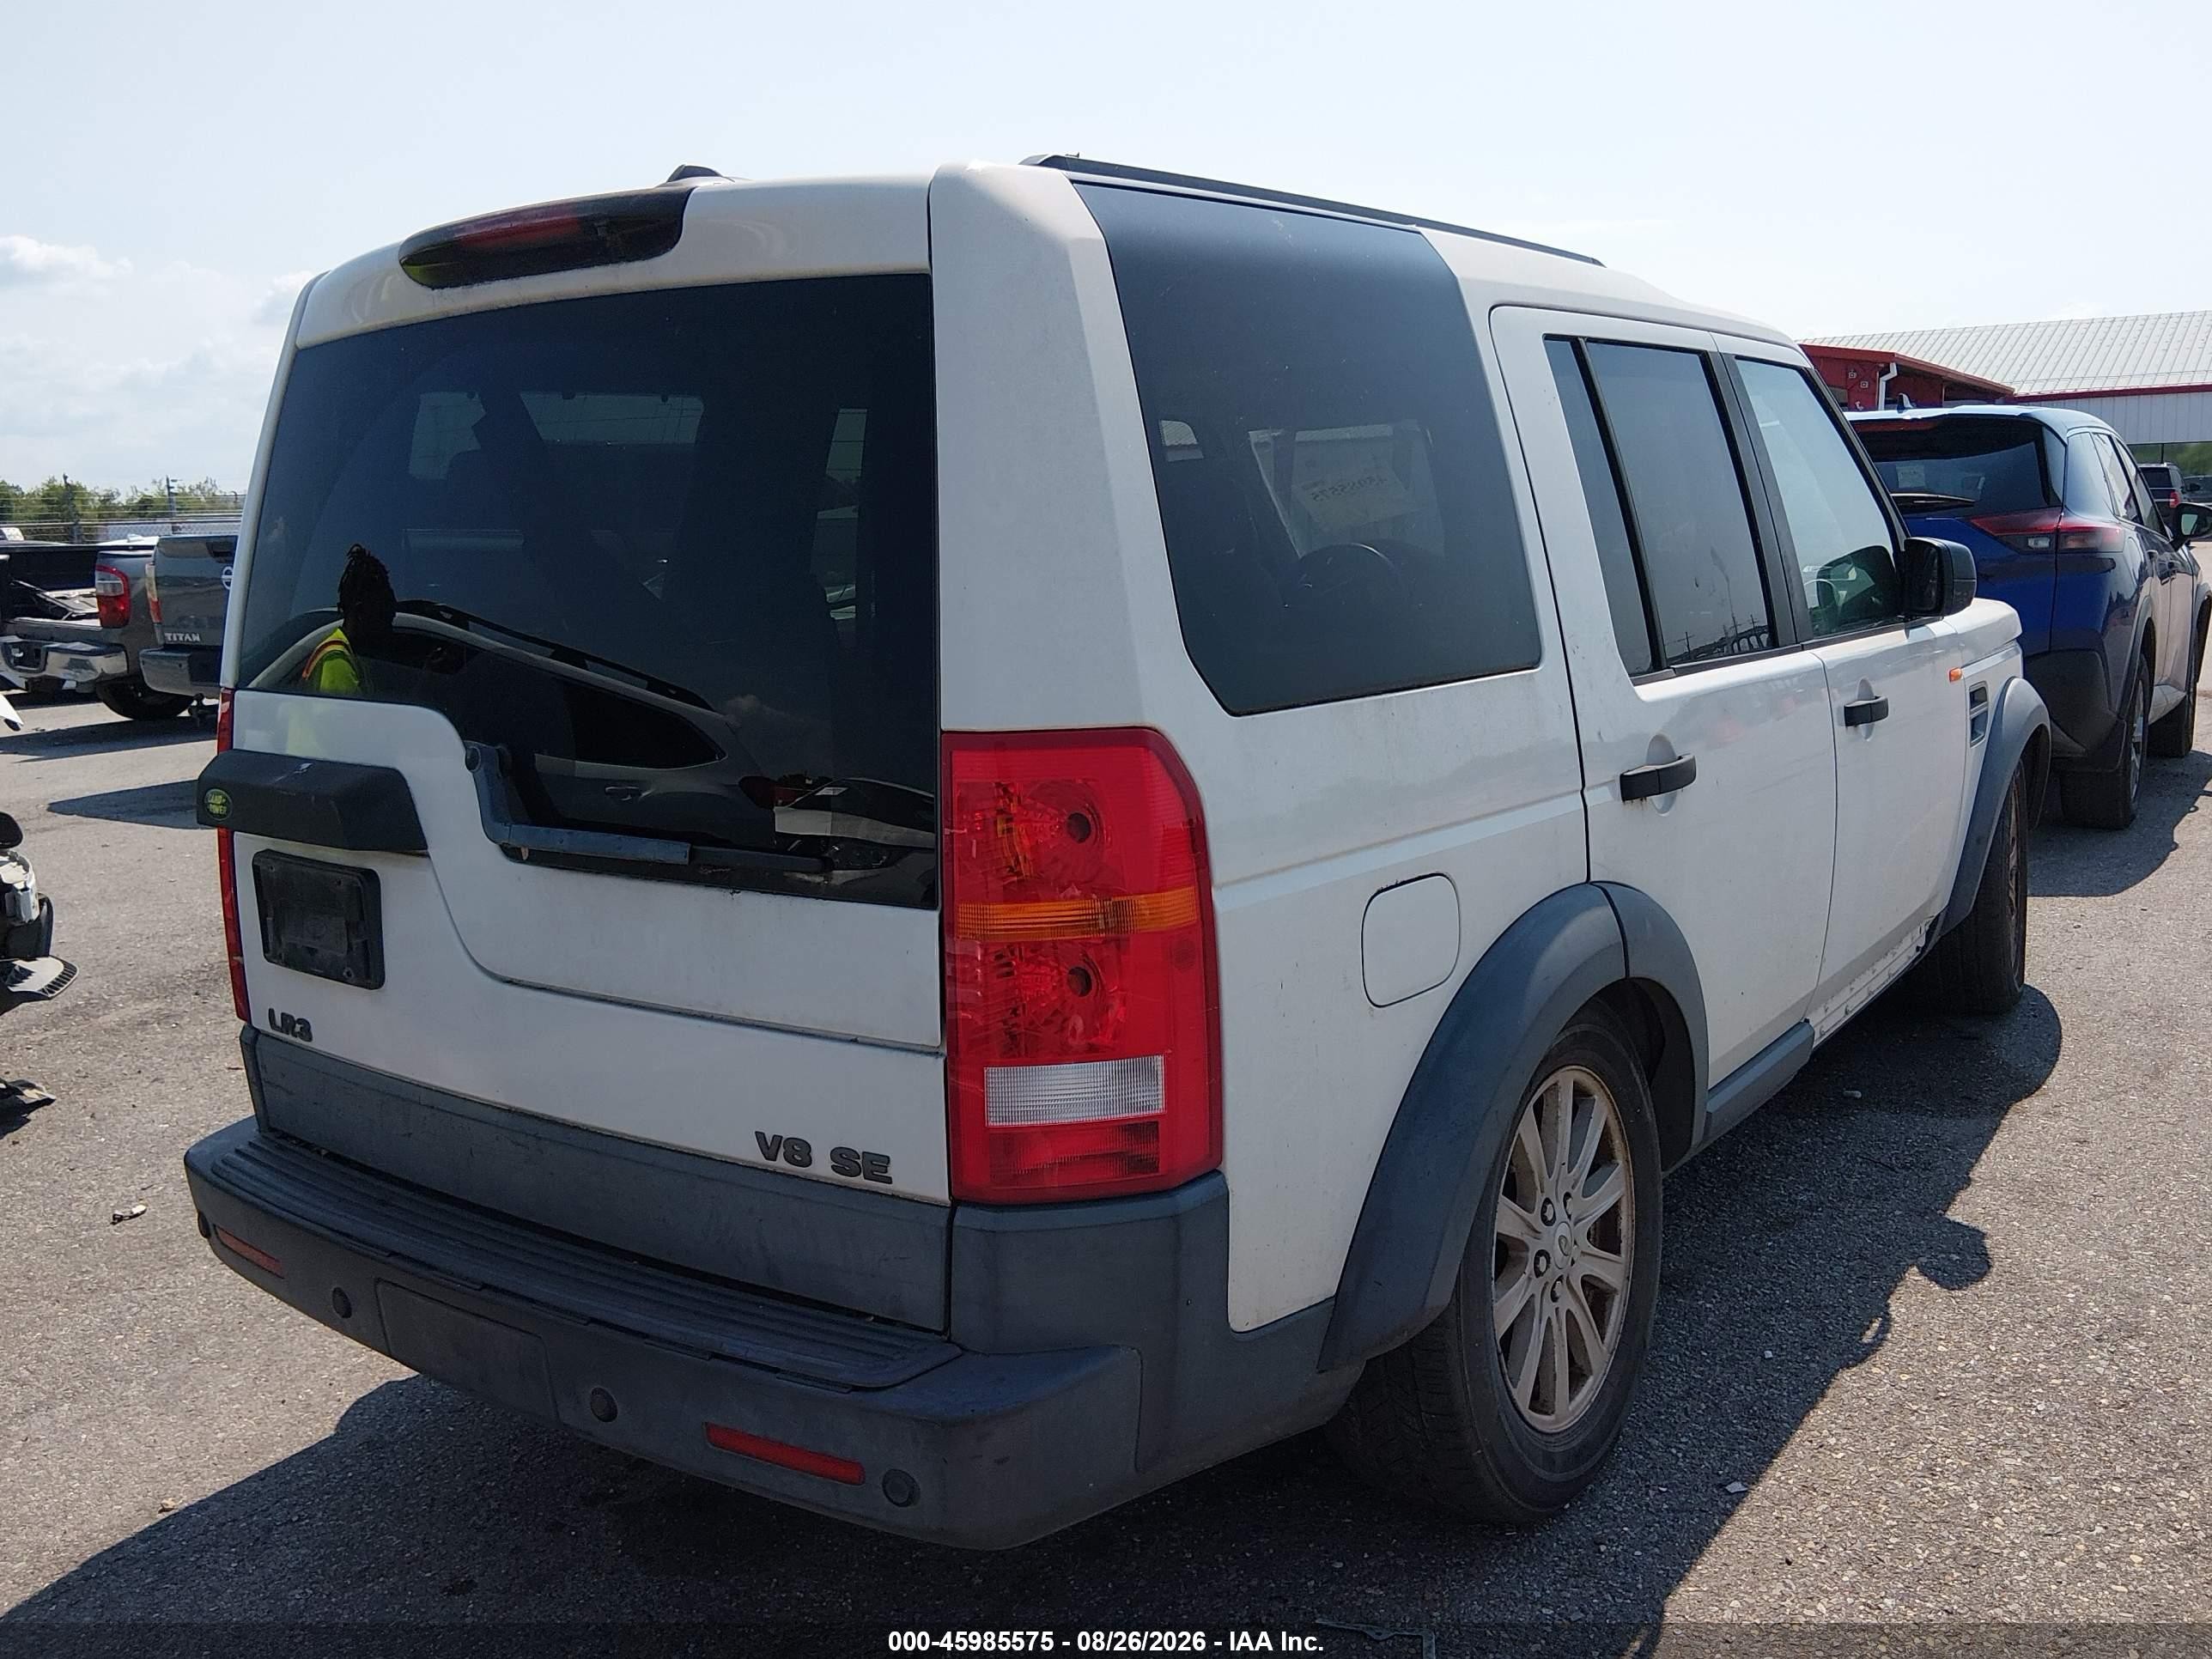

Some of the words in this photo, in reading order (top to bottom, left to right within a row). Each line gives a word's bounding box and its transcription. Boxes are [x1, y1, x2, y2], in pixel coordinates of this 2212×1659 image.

[165, 632, 201, 642] TITAN
[269, 1007, 313, 1042] LR3
[755, 1131, 812, 1168] V8
[830, 1146, 893, 1184] SE
